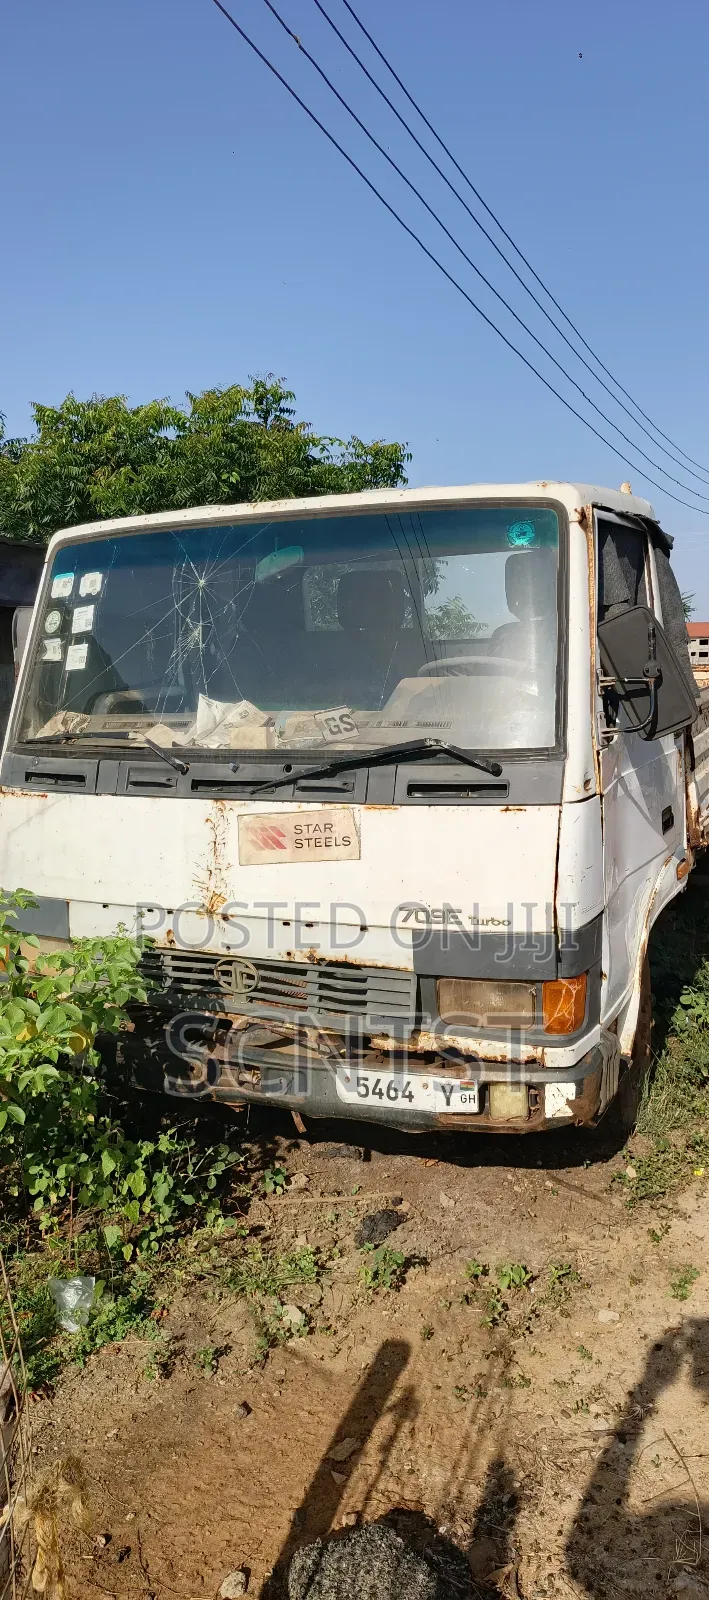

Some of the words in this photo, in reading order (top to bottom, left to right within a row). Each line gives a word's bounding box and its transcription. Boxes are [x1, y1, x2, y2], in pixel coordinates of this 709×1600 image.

[294, 823, 334, 835] STAR
[294, 836, 352, 849] STEELS
[356, 1077, 414, 1103] 5464
[441, 1085, 454, 1106] Y
[460, 1094, 476, 1104] GH
